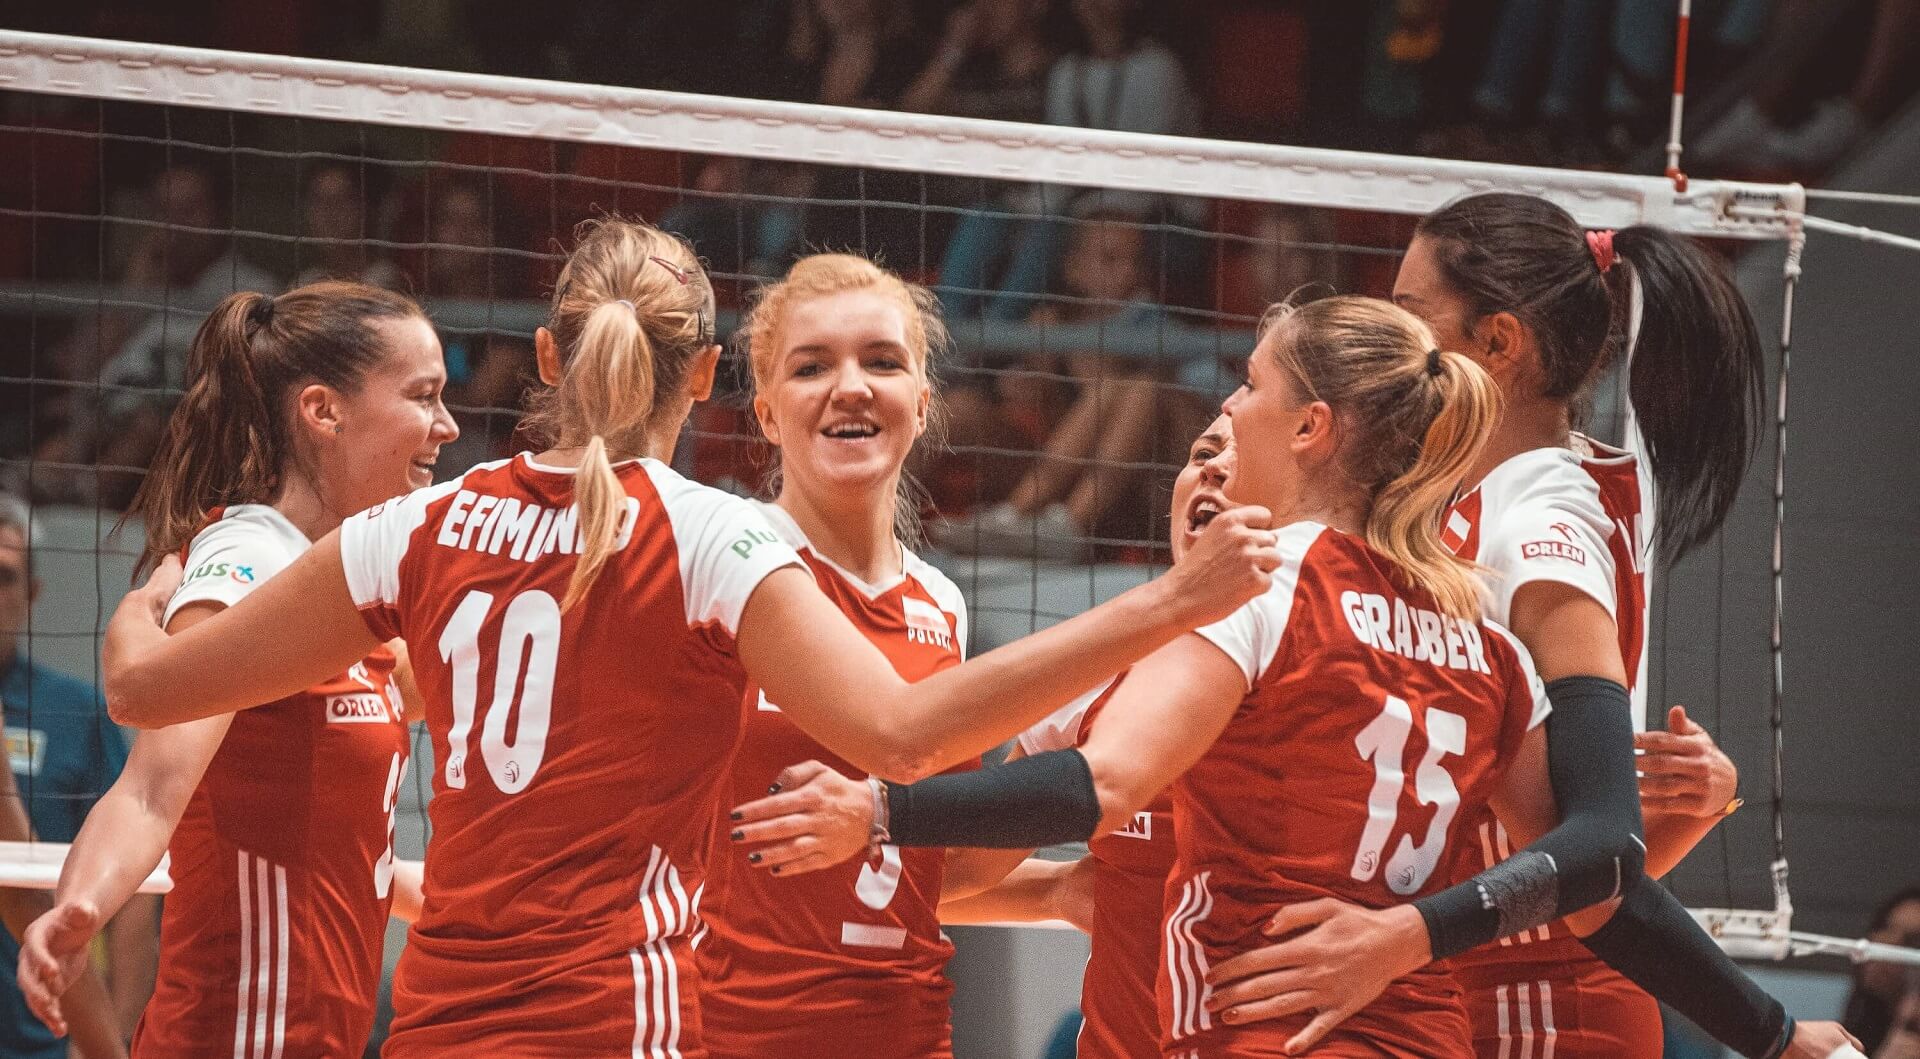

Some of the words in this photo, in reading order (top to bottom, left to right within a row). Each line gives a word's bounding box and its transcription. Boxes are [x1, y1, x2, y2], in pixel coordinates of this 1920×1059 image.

[1525, 543, 1583, 564] ORLEN
[438, 589, 561, 795] 10
[1340, 590, 1491, 676] GRAJBER
[1350, 694, 1467, 896] 15
